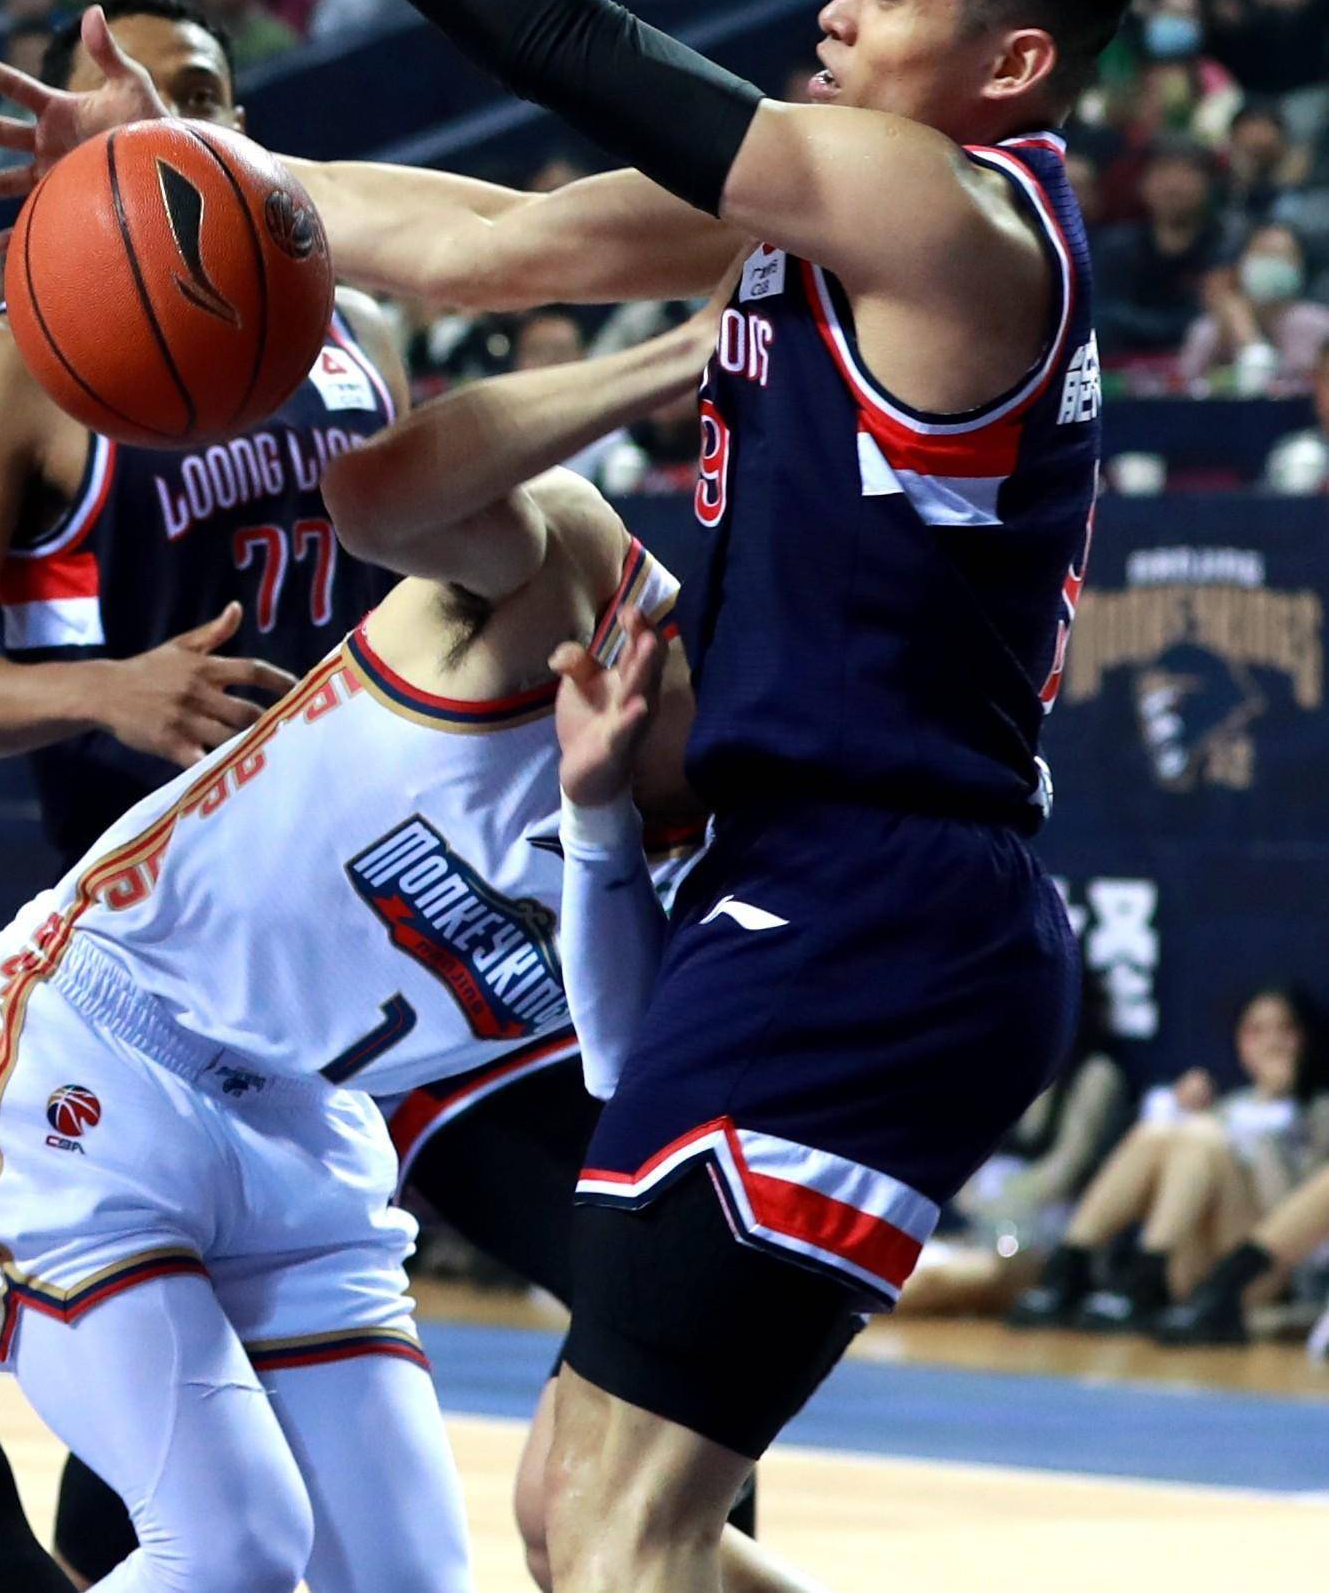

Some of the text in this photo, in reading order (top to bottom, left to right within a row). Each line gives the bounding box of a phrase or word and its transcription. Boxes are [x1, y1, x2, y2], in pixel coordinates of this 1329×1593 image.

[154, 431, 284, 541] LOONG
[233, 518, 338, 634] 77
[320, 992, 418, 1085] 1
[45, 1134, 86, 1155] CBA
